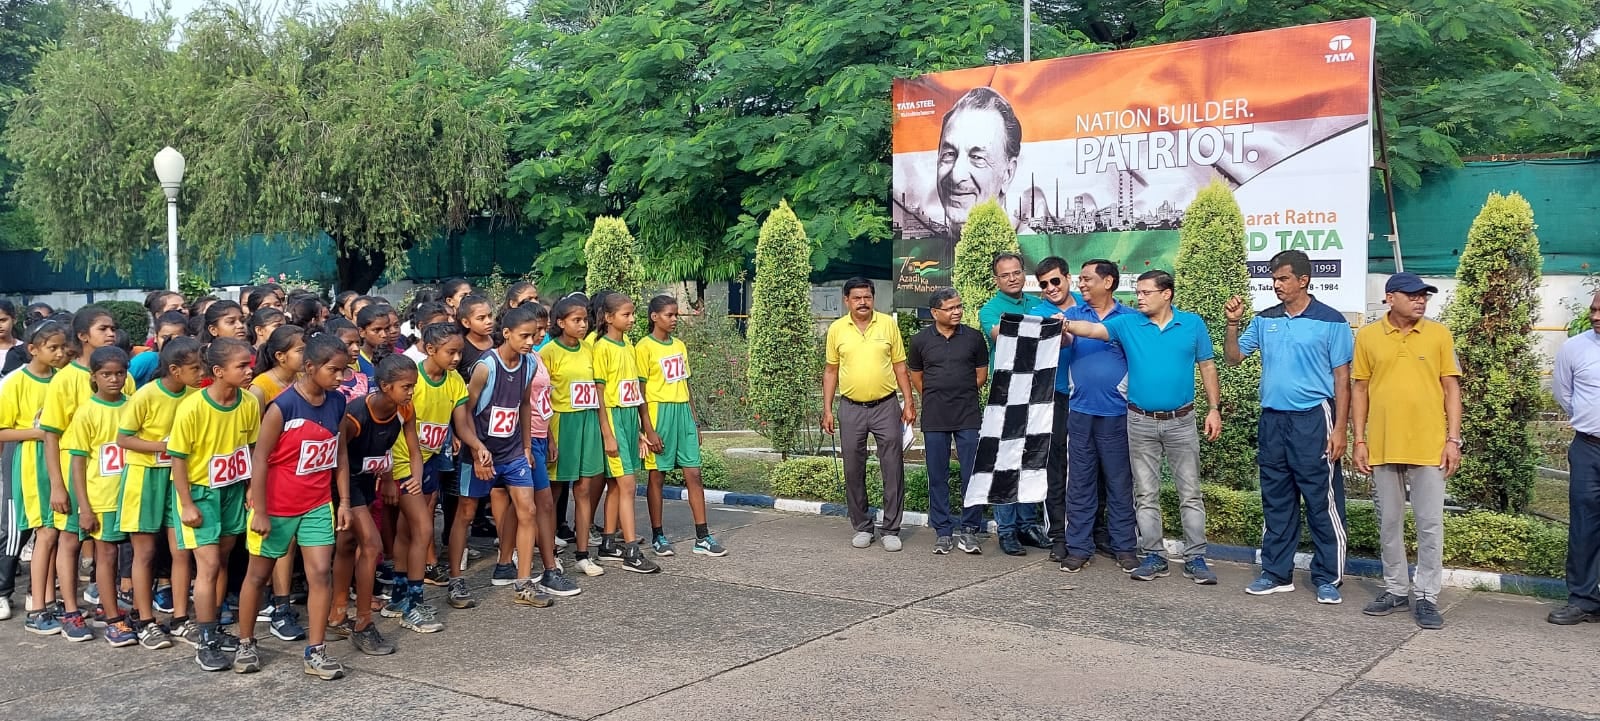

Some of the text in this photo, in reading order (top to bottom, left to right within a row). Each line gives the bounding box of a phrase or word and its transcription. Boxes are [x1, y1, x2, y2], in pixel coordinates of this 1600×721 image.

[1324, 52, 1355, 63] TATA
[897, 99, 936, 110] TATA STEEL
[1075, 98, 1254, 133] NATION BUILDER.
[1075, 123, 1260, 174] PATRIOT.
[1285, 209, 1337, 225] Ratna
[1275, 229, 1344, 251] TATA
[1314, 264, 1337, 273] 1993
[899, 274, 920, 283] Azadi
[303, 440, 337, 470] 232
[213, 450, 247, 483] 286
